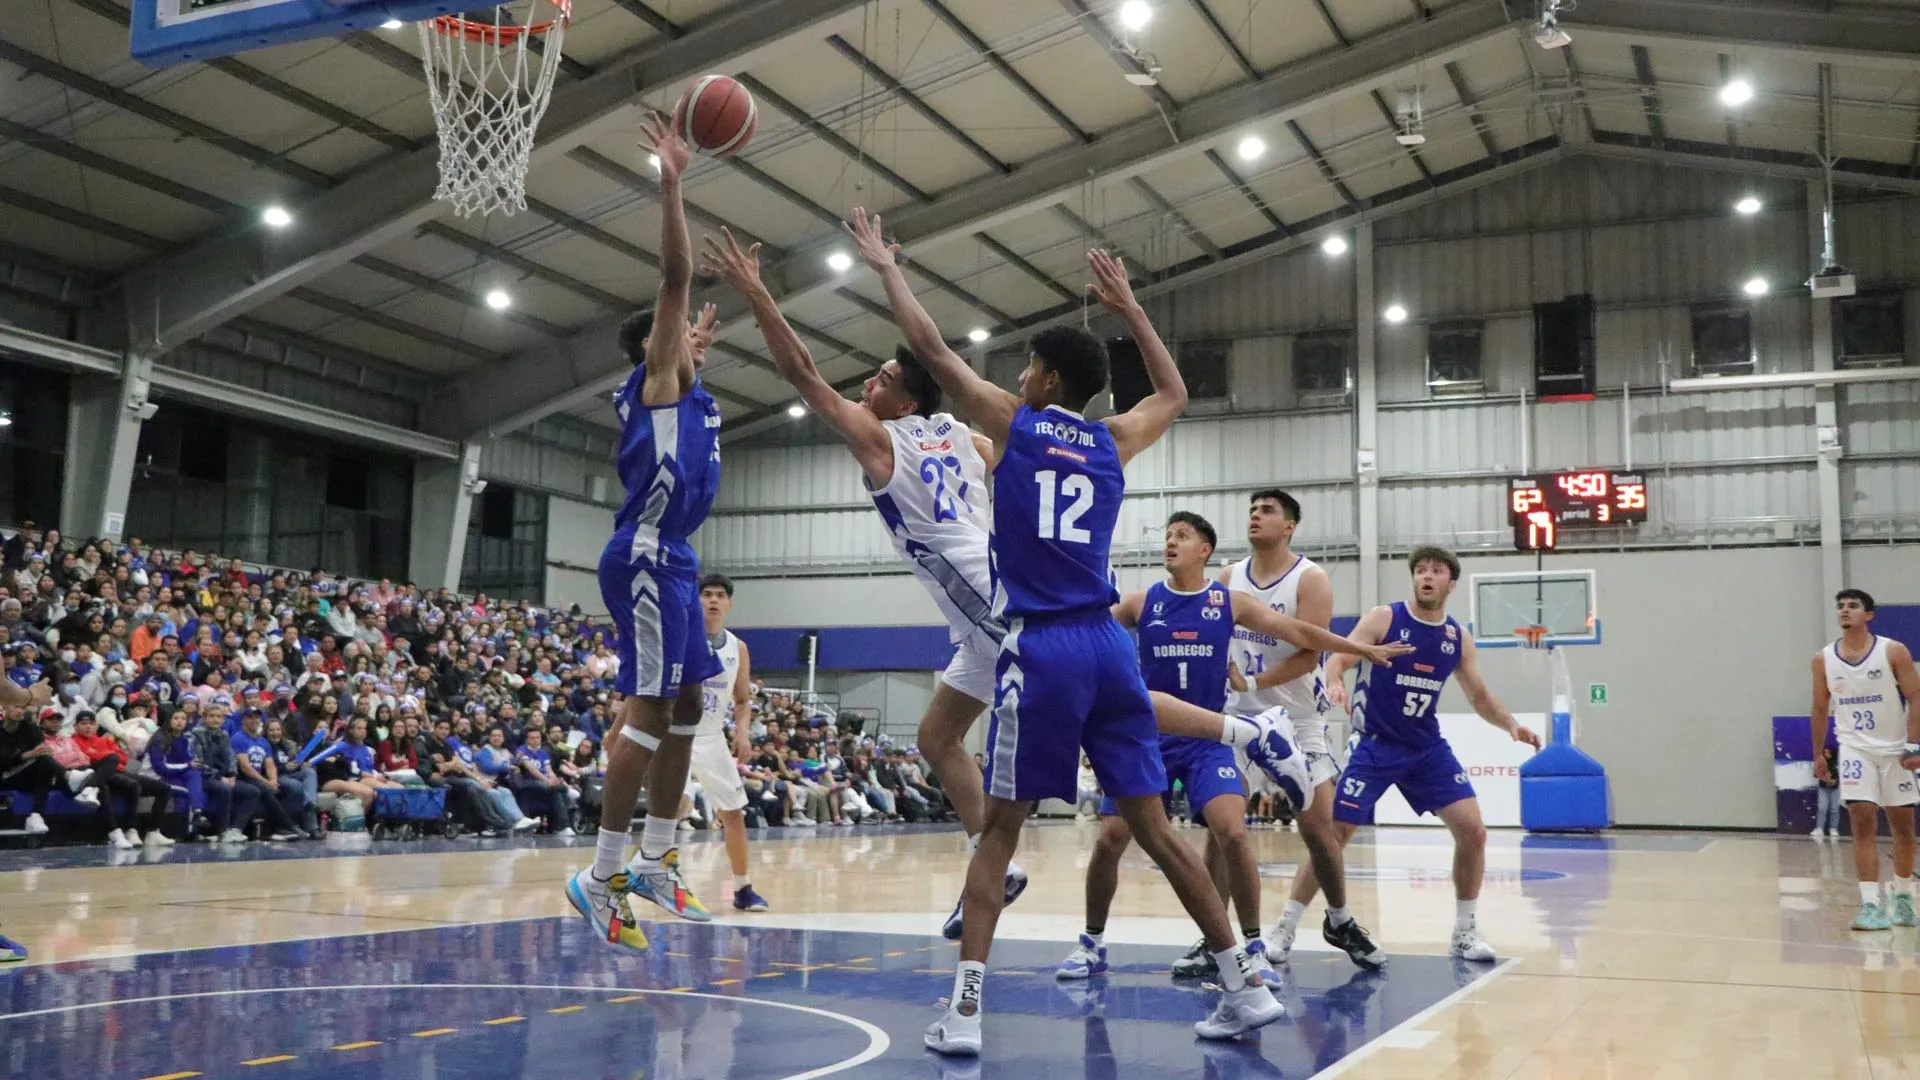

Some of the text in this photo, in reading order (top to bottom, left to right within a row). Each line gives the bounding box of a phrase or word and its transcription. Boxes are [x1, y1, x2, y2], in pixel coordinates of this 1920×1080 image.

[1035, 422, 1096, 447] TEC TOL
[1558, 473, 1606, 497] 4:50
[1616, 485, 1645, 509] 35
[1034, 469, 1095, 544] 12
[1597, 504, 1609, 521] 3
[1153, 644, 1214, 658] BORREGOS
[1243, 650, 1264, 676] 21
[1178, 662, 1188, 689] 1
[1403, 691, 1432, 718] 57
[1839, 694, 1884, 705] BORREGOS
[1853, 710, 1876, 730] 23
[1842, 759, 1863, 779] 23
[1343, 777, 1366, 798] 57
